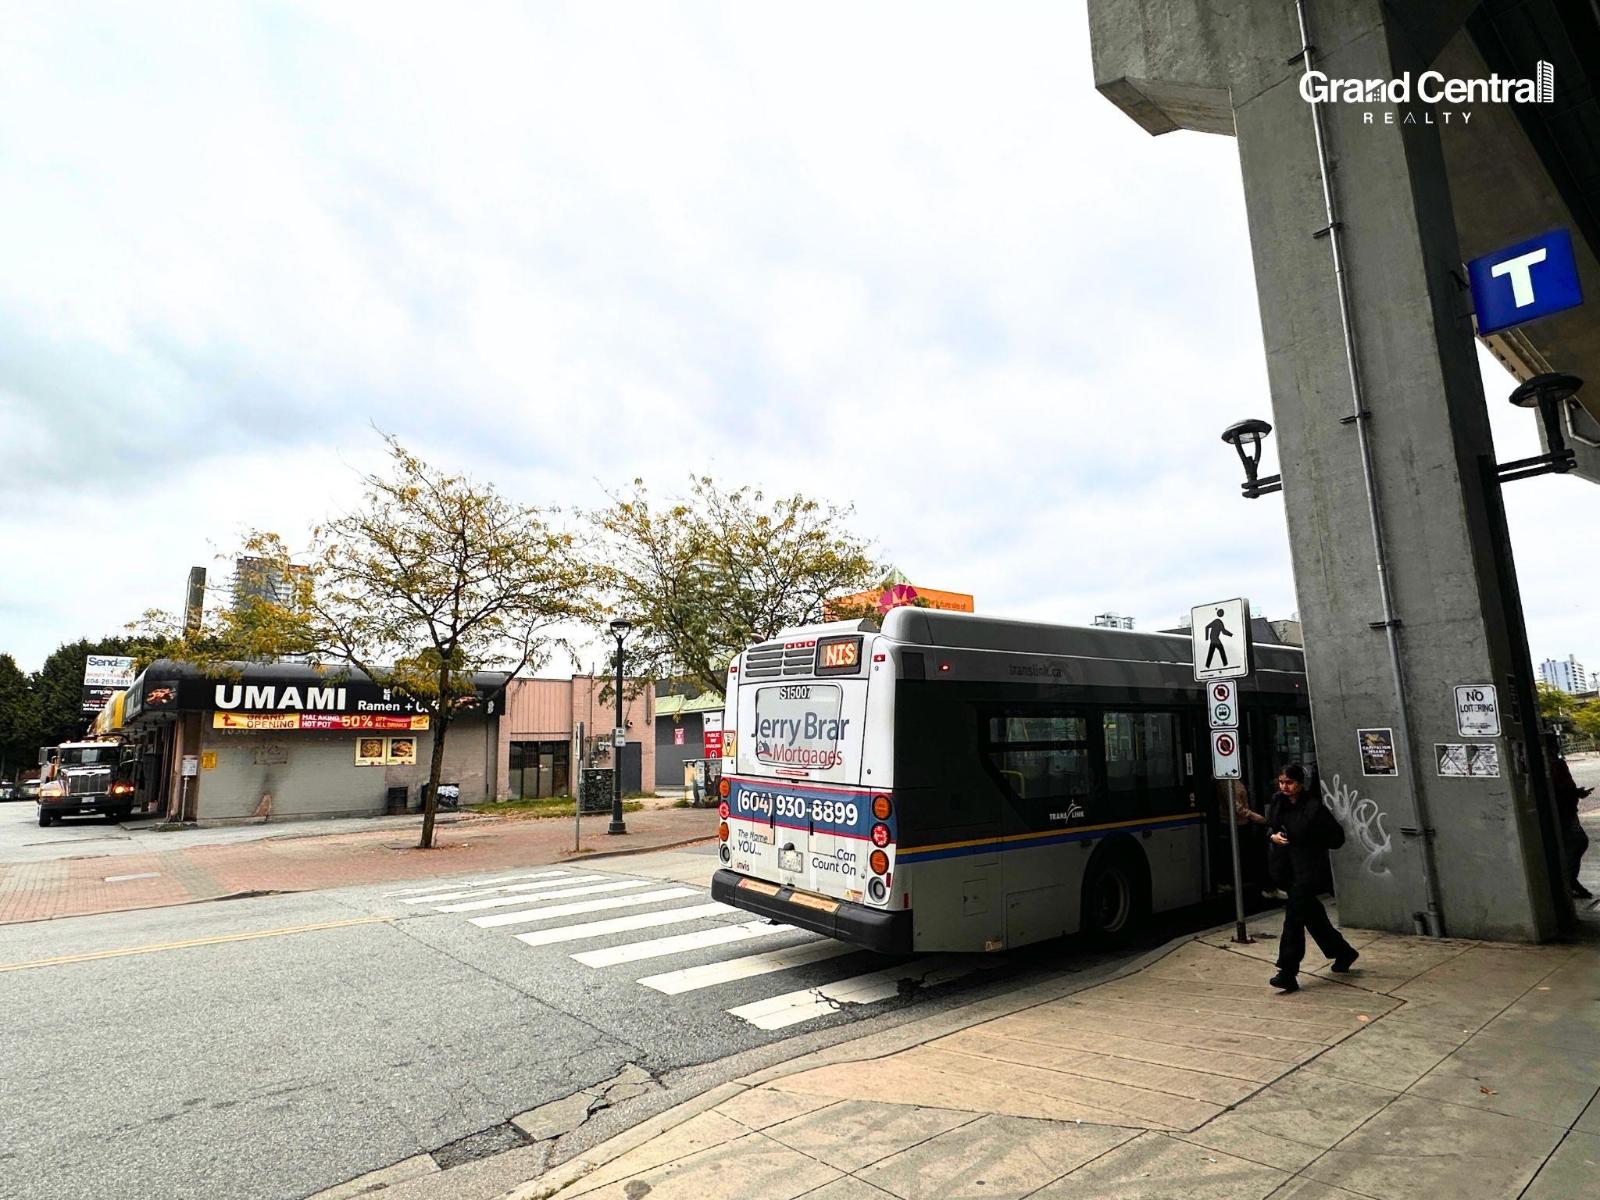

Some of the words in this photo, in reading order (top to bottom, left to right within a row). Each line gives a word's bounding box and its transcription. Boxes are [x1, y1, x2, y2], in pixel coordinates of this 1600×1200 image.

[1491, 247, 1546, 308] T
[826, 642, 855, 667] NIS
[215, 684, 347, 710] UMAMI
[780, 686, 812, 699] S15007
[1466, 691, 1484, 702] NO
[358, 700, 400, 711] Ramen
[246, 720, 294, 728] OPENING
[342, 715, 373, 727] 50%
[751, 712, 806, 746] Jerry
[804, 711, 850, 741] Brar
[773, 743, 844, 768] Mortgages
[737, 789, 773, 816] (604)
[776, 795, 858, 826] 930-8899
[738, 829, 749, 838] The
[749, 832, 768, 843] Name
[812, 857, 840, 873] Count
[842, 863, 857, 876] On
